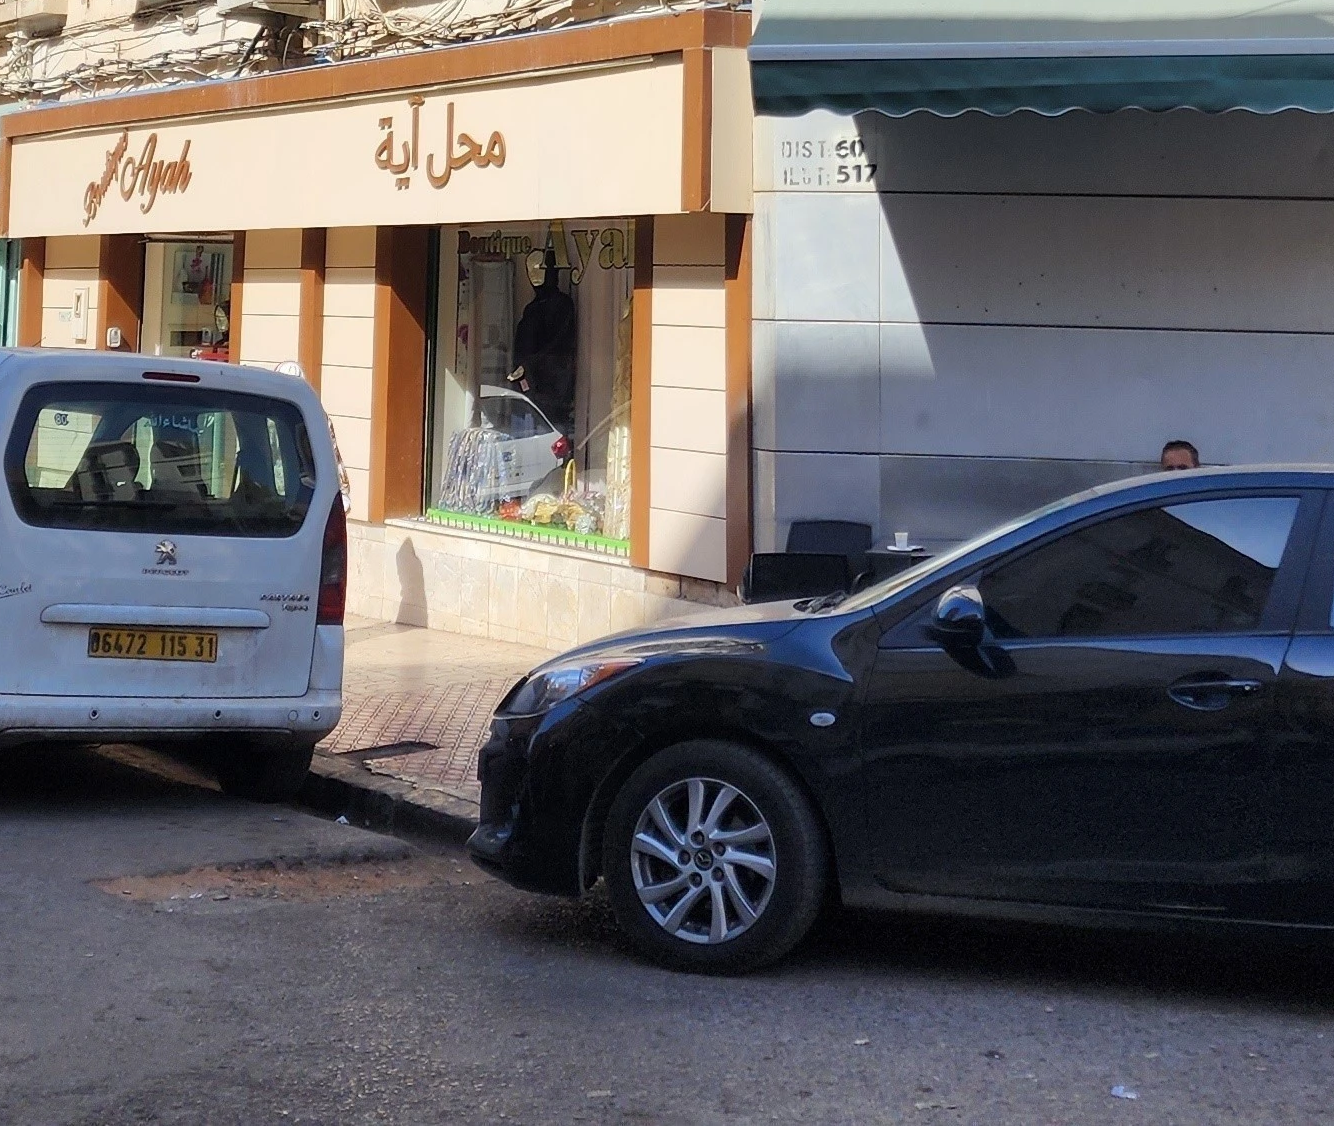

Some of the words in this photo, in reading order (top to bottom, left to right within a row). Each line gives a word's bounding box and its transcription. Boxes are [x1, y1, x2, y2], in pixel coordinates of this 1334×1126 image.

[374, 94, 425, 191] آية
[426, 101, 506, 190] محل
[835, 139, 865, 159] 60
[120, 132, 192, 215] Ayah
[836, 164, 877, 184] 517
[456, 229, 532, 260] Boutique
[90, 632, 147, 655] 06472
[160, 634, 187, 656] 115
[194, 637, 214, 657] 31
